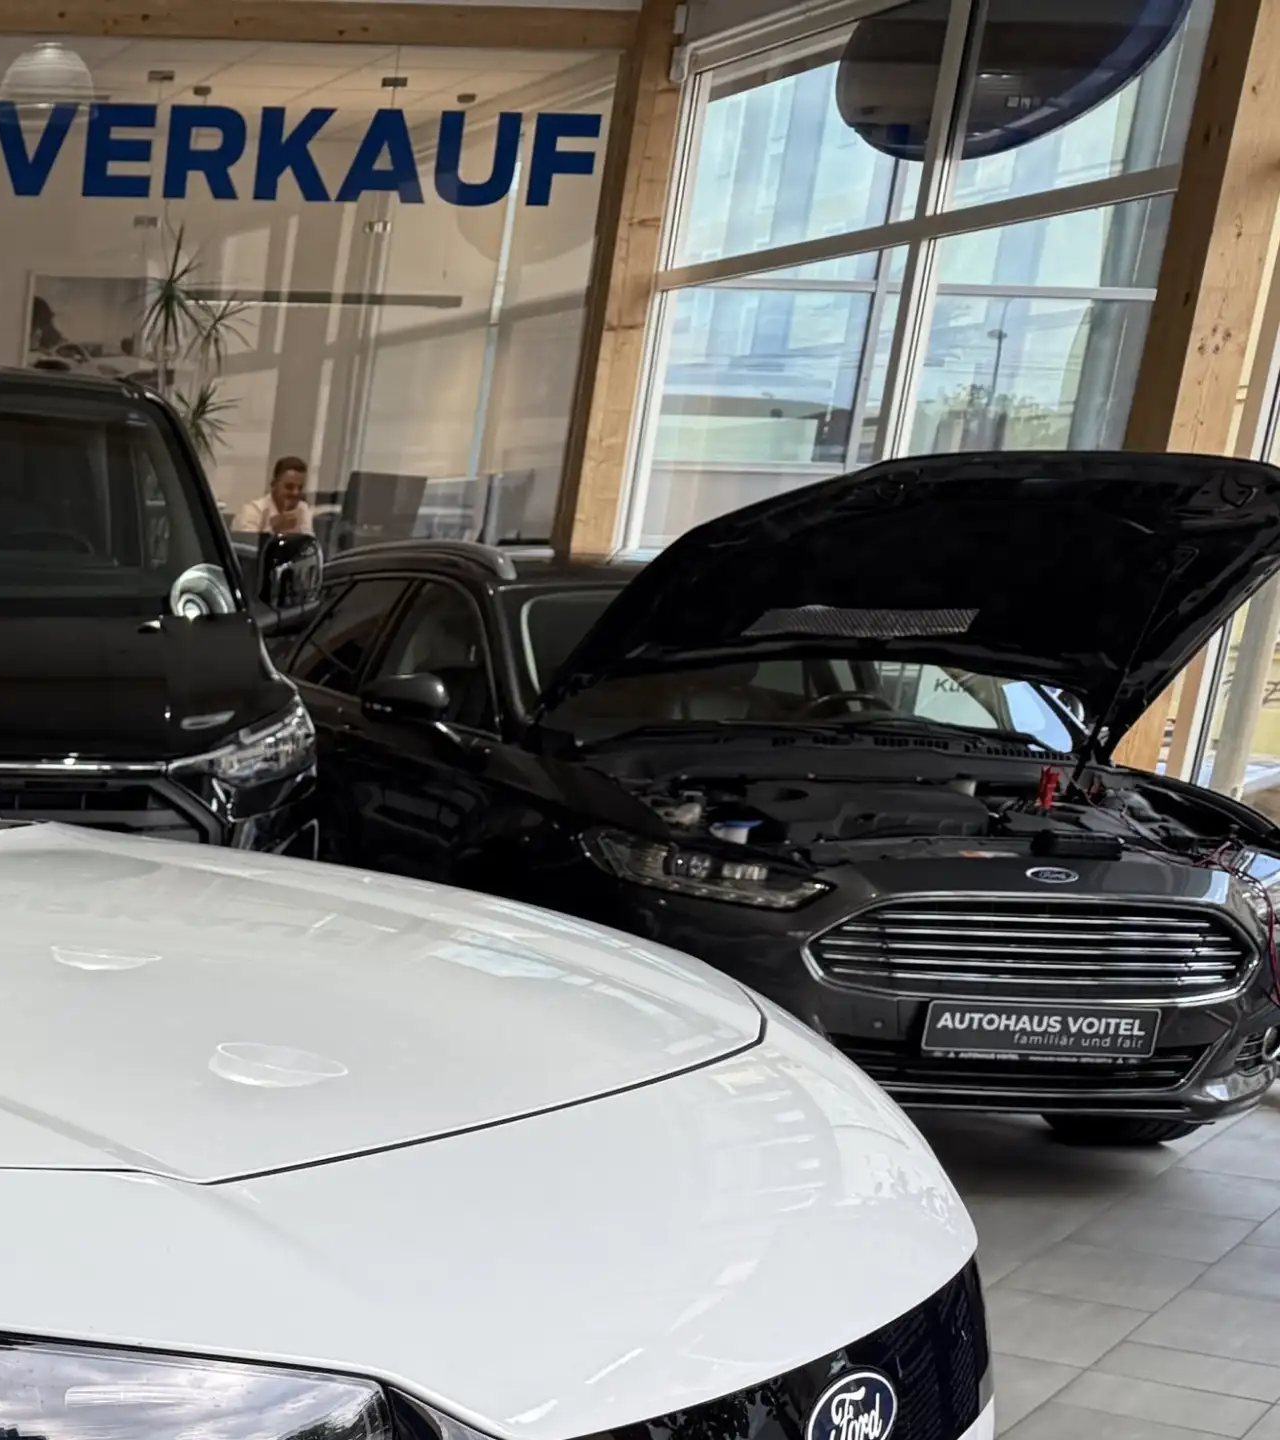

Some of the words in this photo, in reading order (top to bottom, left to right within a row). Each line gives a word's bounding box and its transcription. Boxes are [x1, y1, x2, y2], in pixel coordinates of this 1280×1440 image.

[936, 1012, 1062, 1033] AUTOHAUS
[1067, 1016, 1145, 1036] VOITEL
[1013, 1033, 1075, 1047] familiär
[1081, 1035, 1111, 1048] und
[1117, 1036, 1144, 1049] fair
